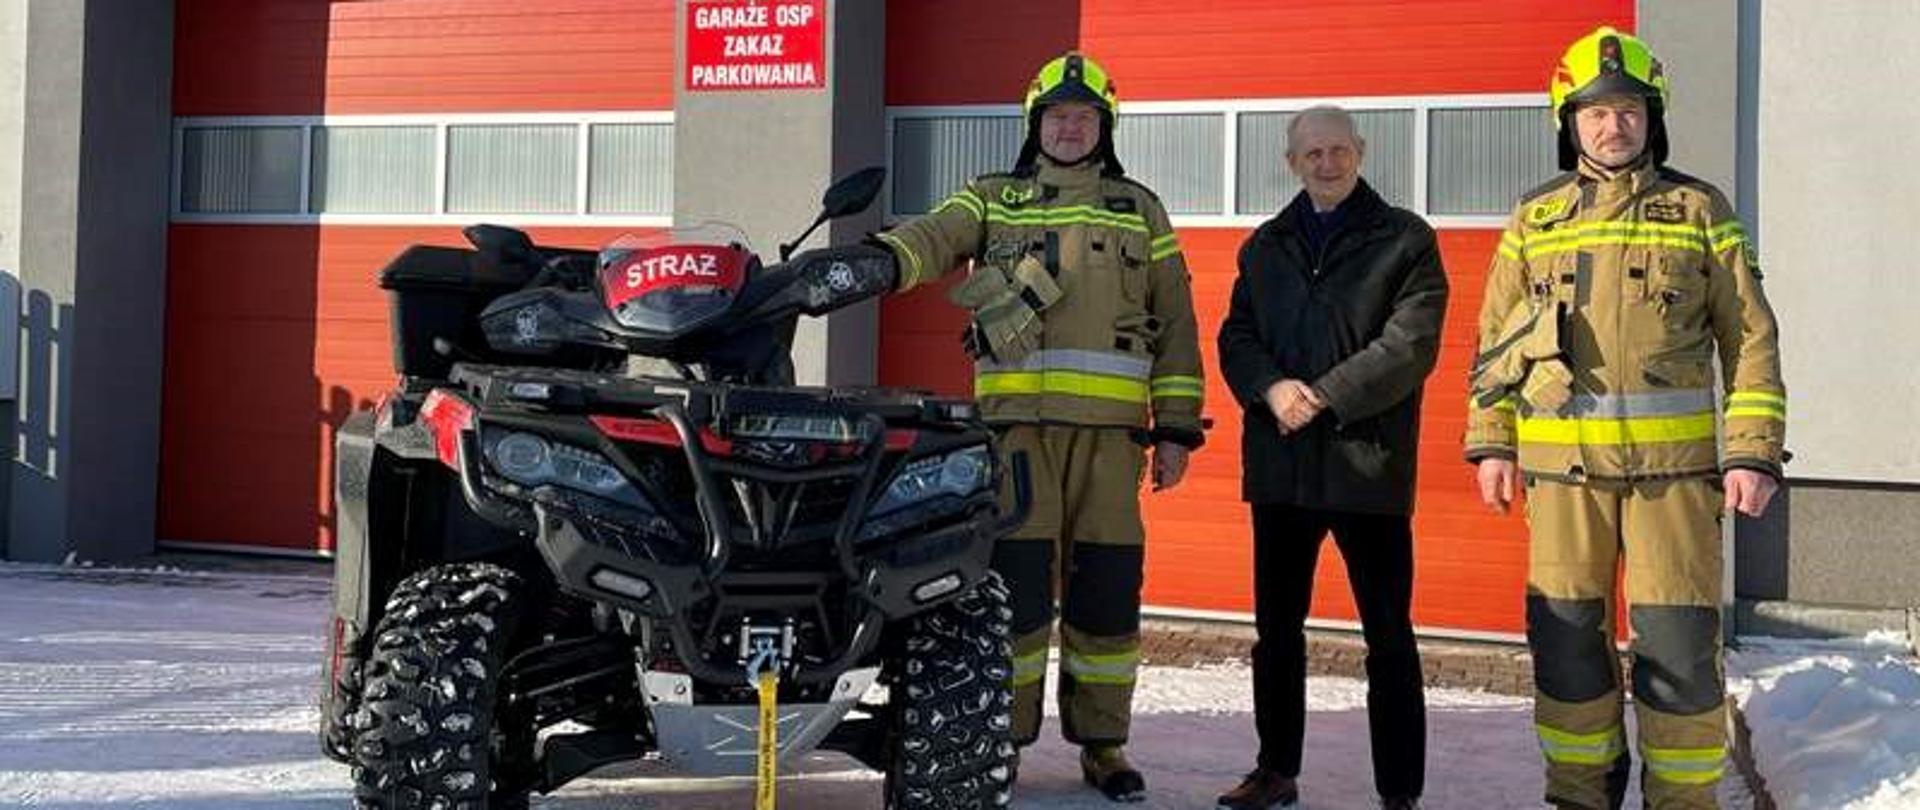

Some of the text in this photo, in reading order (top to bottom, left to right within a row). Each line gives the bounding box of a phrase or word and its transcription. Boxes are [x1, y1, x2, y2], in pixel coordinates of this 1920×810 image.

[695, 2, 814, 28] GARAŻE OSP
[724, 33, 784, 56] ZAKAZ
[692, 62, 816, 85] PARKOWANIA
